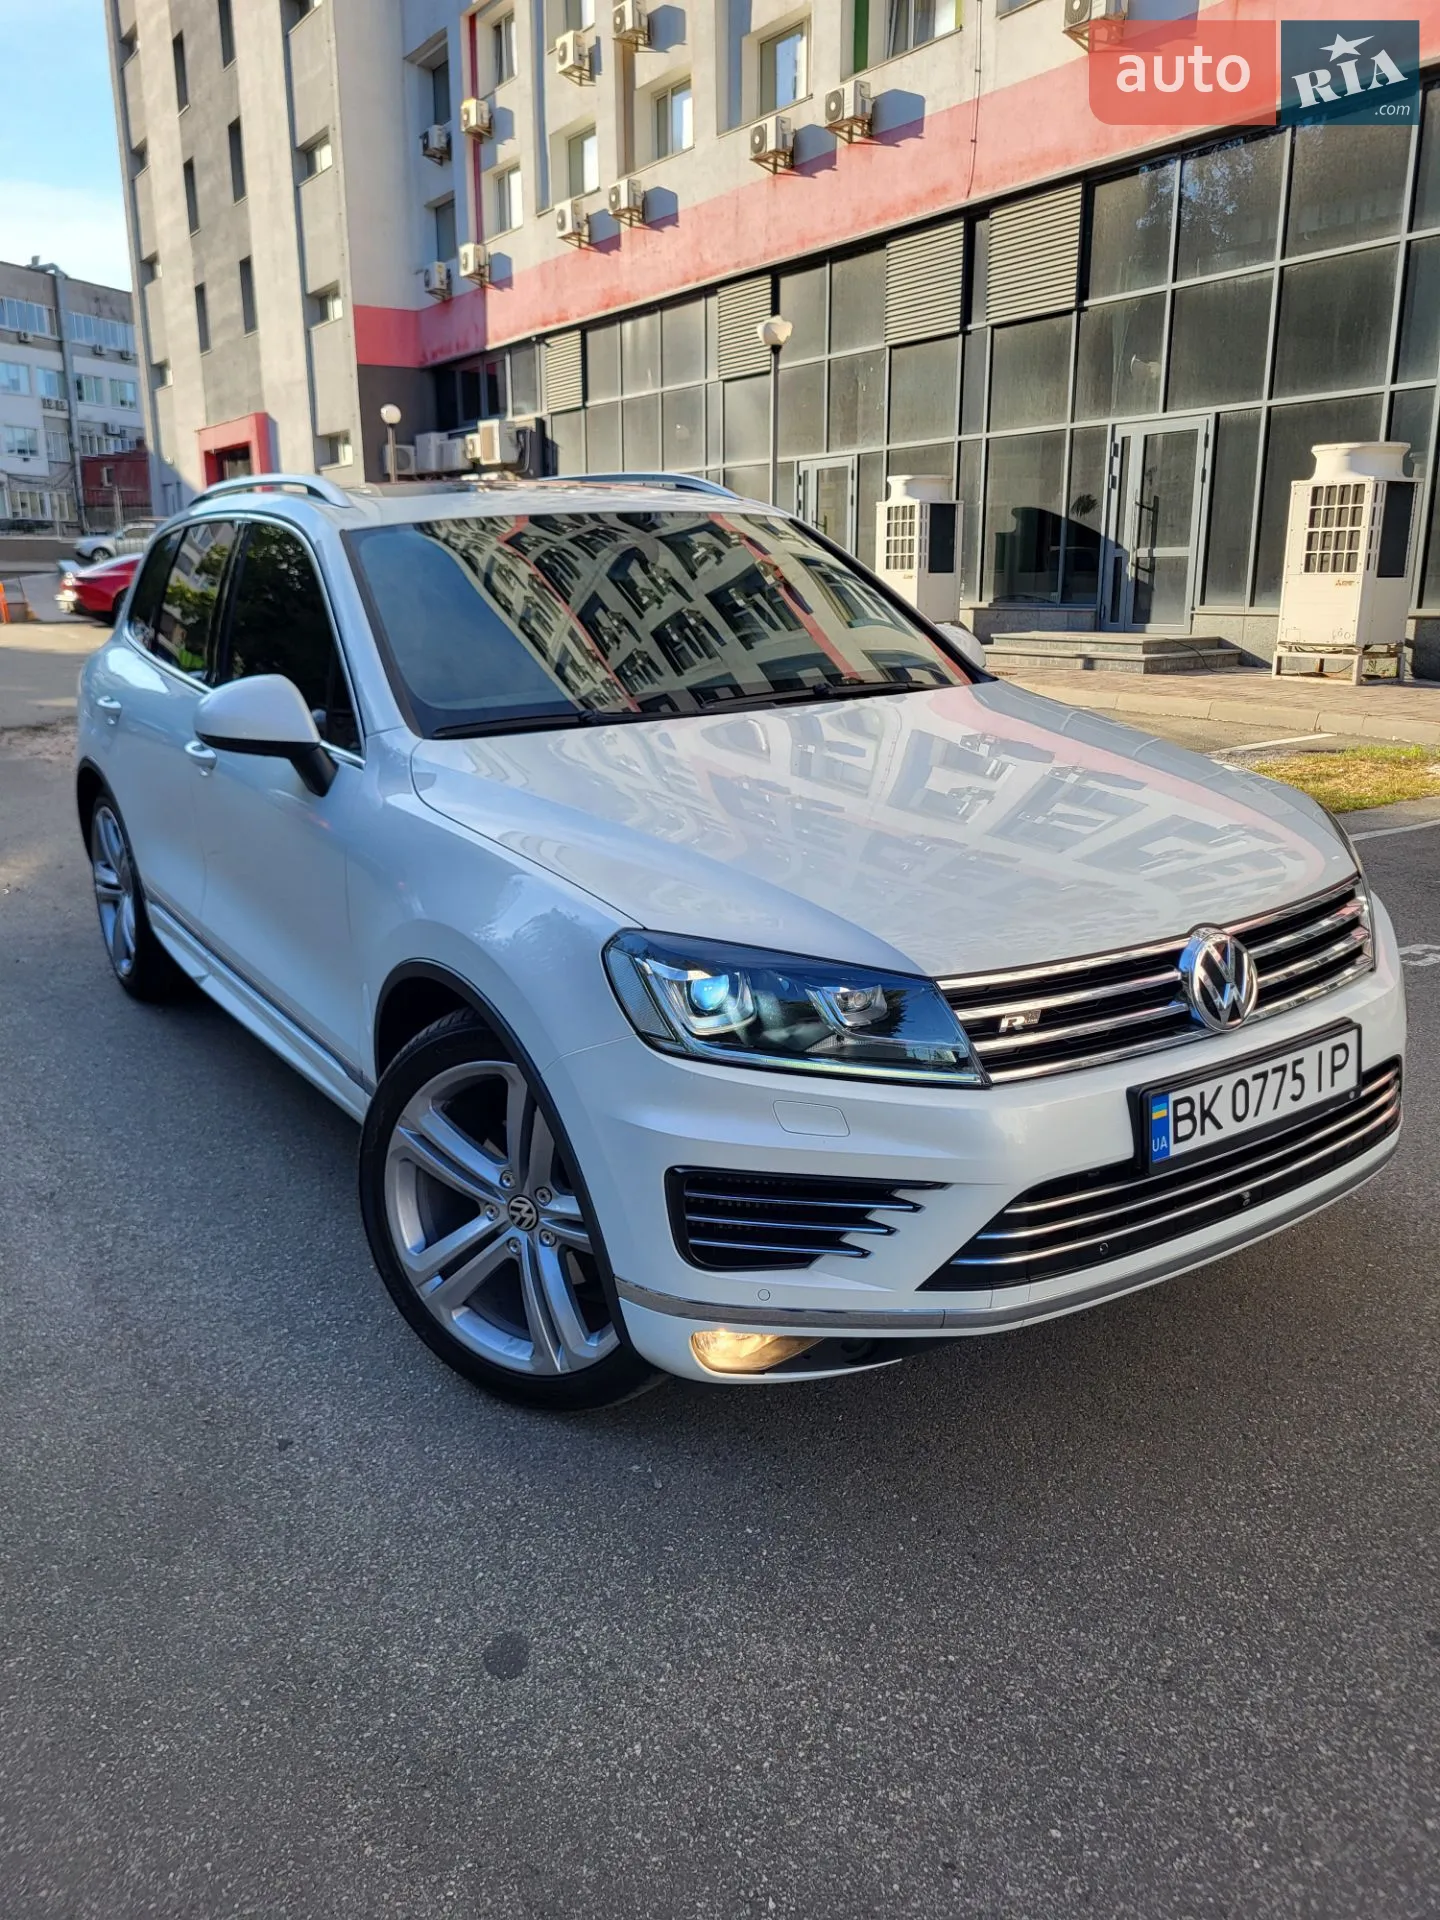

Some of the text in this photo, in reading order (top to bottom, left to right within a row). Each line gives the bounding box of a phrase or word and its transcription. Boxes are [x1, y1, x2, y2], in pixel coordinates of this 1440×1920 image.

[1172, 1042, 1350, 1145] BK 0775 IP
[1152, 1138, 1168, 1153] UA
